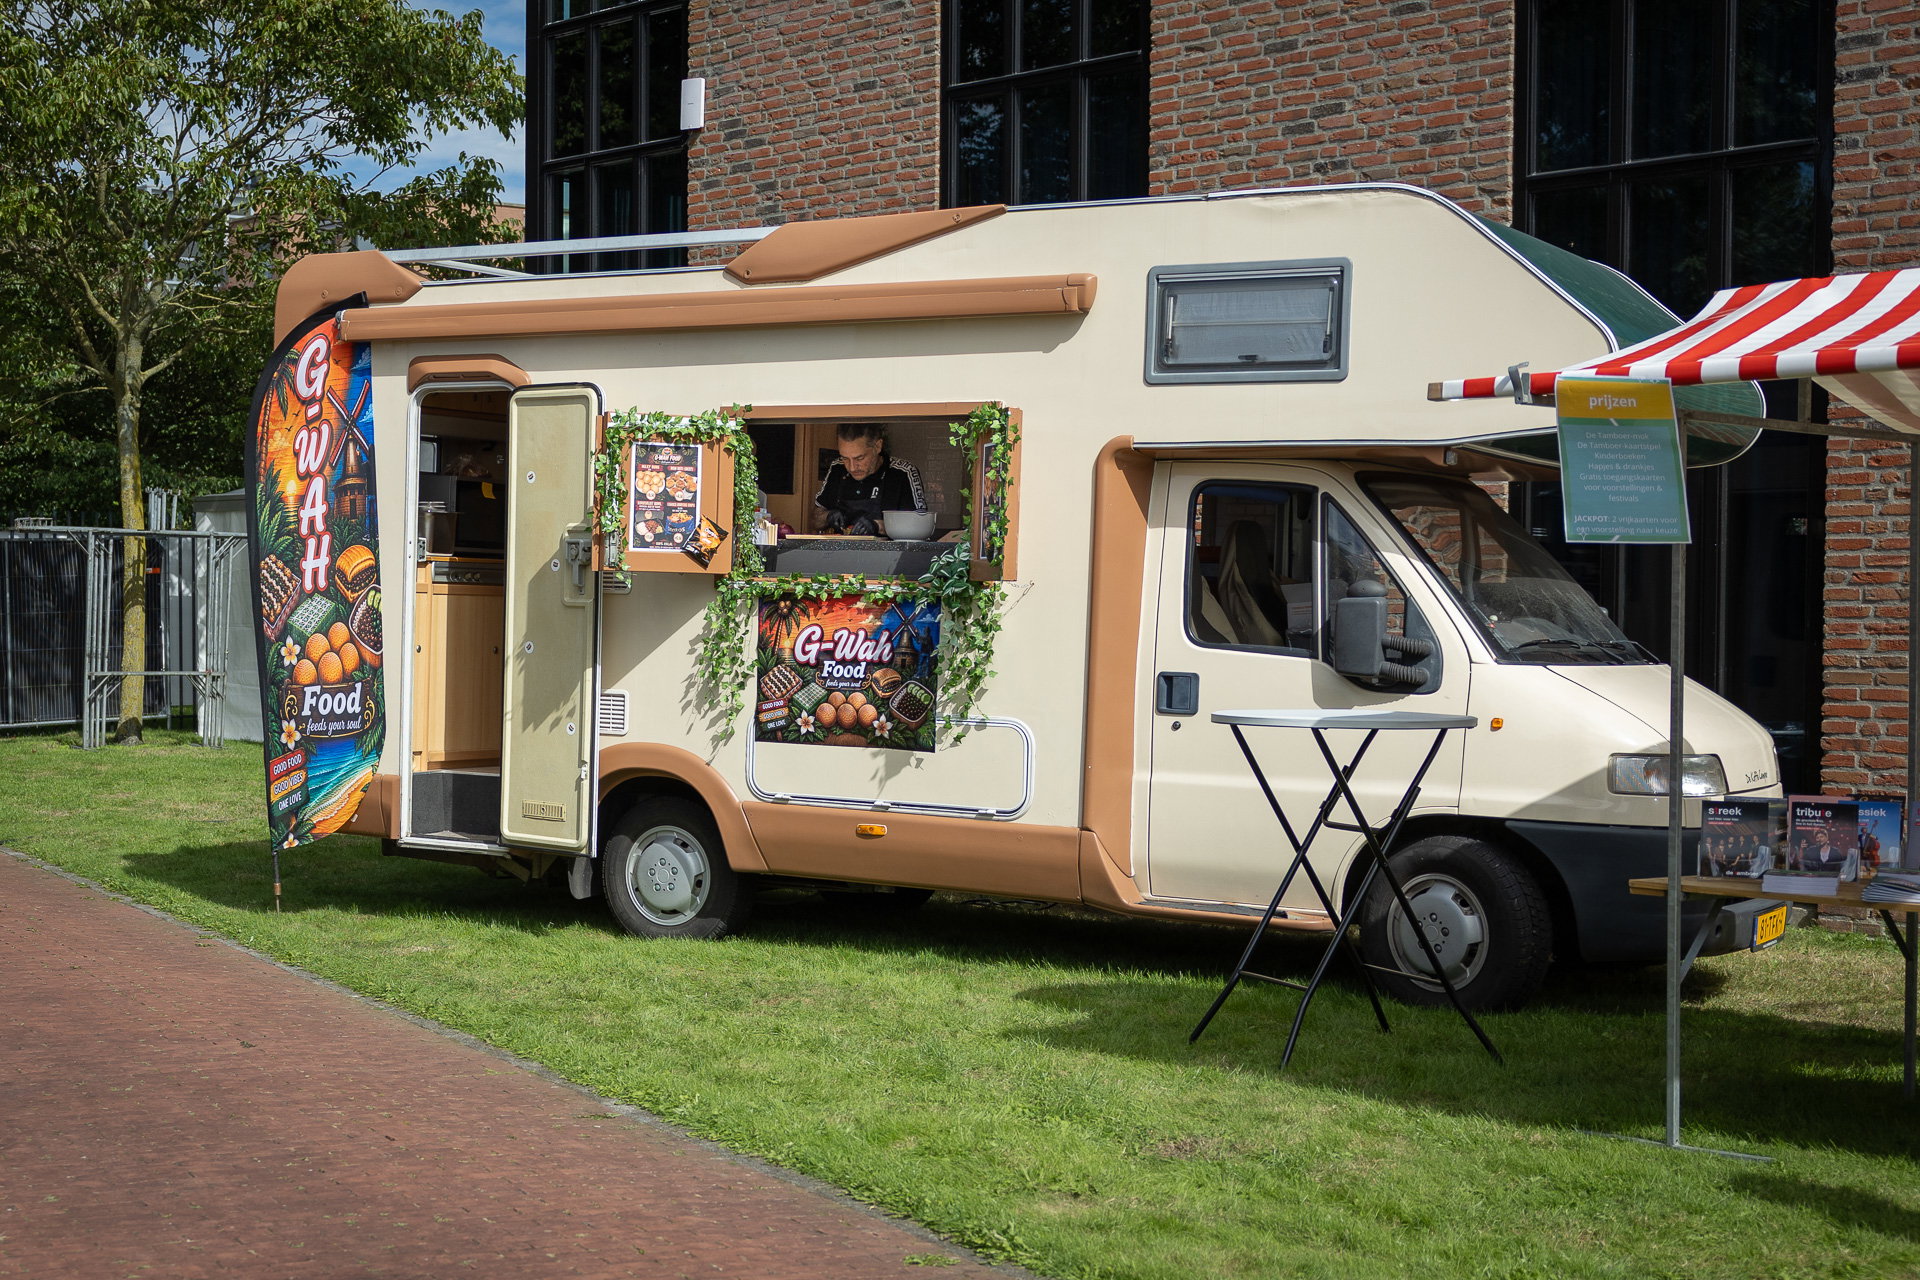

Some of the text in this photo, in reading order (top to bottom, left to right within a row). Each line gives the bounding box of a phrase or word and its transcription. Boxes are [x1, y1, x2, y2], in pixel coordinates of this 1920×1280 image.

[1589, 395, 1637, 410] prijzen
[1585, 431, 1596, 439] De
[1577, 441, 1588, 449] De
[1594, 452, 1646, 460] Kinderboeken
[1588, 463, 1614, 472] Hapjes
[1622, 463, 1655, 472] drankjes
[1579, 473, 1666, 483] Gratis toegangskaarten
[1602, 485, 1655, 493] voorstellingen
[1608, 494, 1640, 502] festivals
[1619, 516, 1659, 525] vrijkaarten
[1591, 526, 1635, 535] voorstelling
[1655, 526, 1678, 534] keuze
[794, 624, 893, 665] G-Wah
[821, 660, 867, 679] Food
[301, 682, 362, 716] Food
[762, 700, 784, 710] GOOD FOOD
[306, 715, 362, 736] feeds your soul
[273, 754, 302, 775] GOOD FOOD
[273, 772, 303, 795] GOOD VIBES
[278, 791, 302, 811] ONE LOVE
[1708, 806, 1742, 816] streek
[1796, 807, 1832, 818] tribute
[1858, 808, 1887, 817] ssiek
